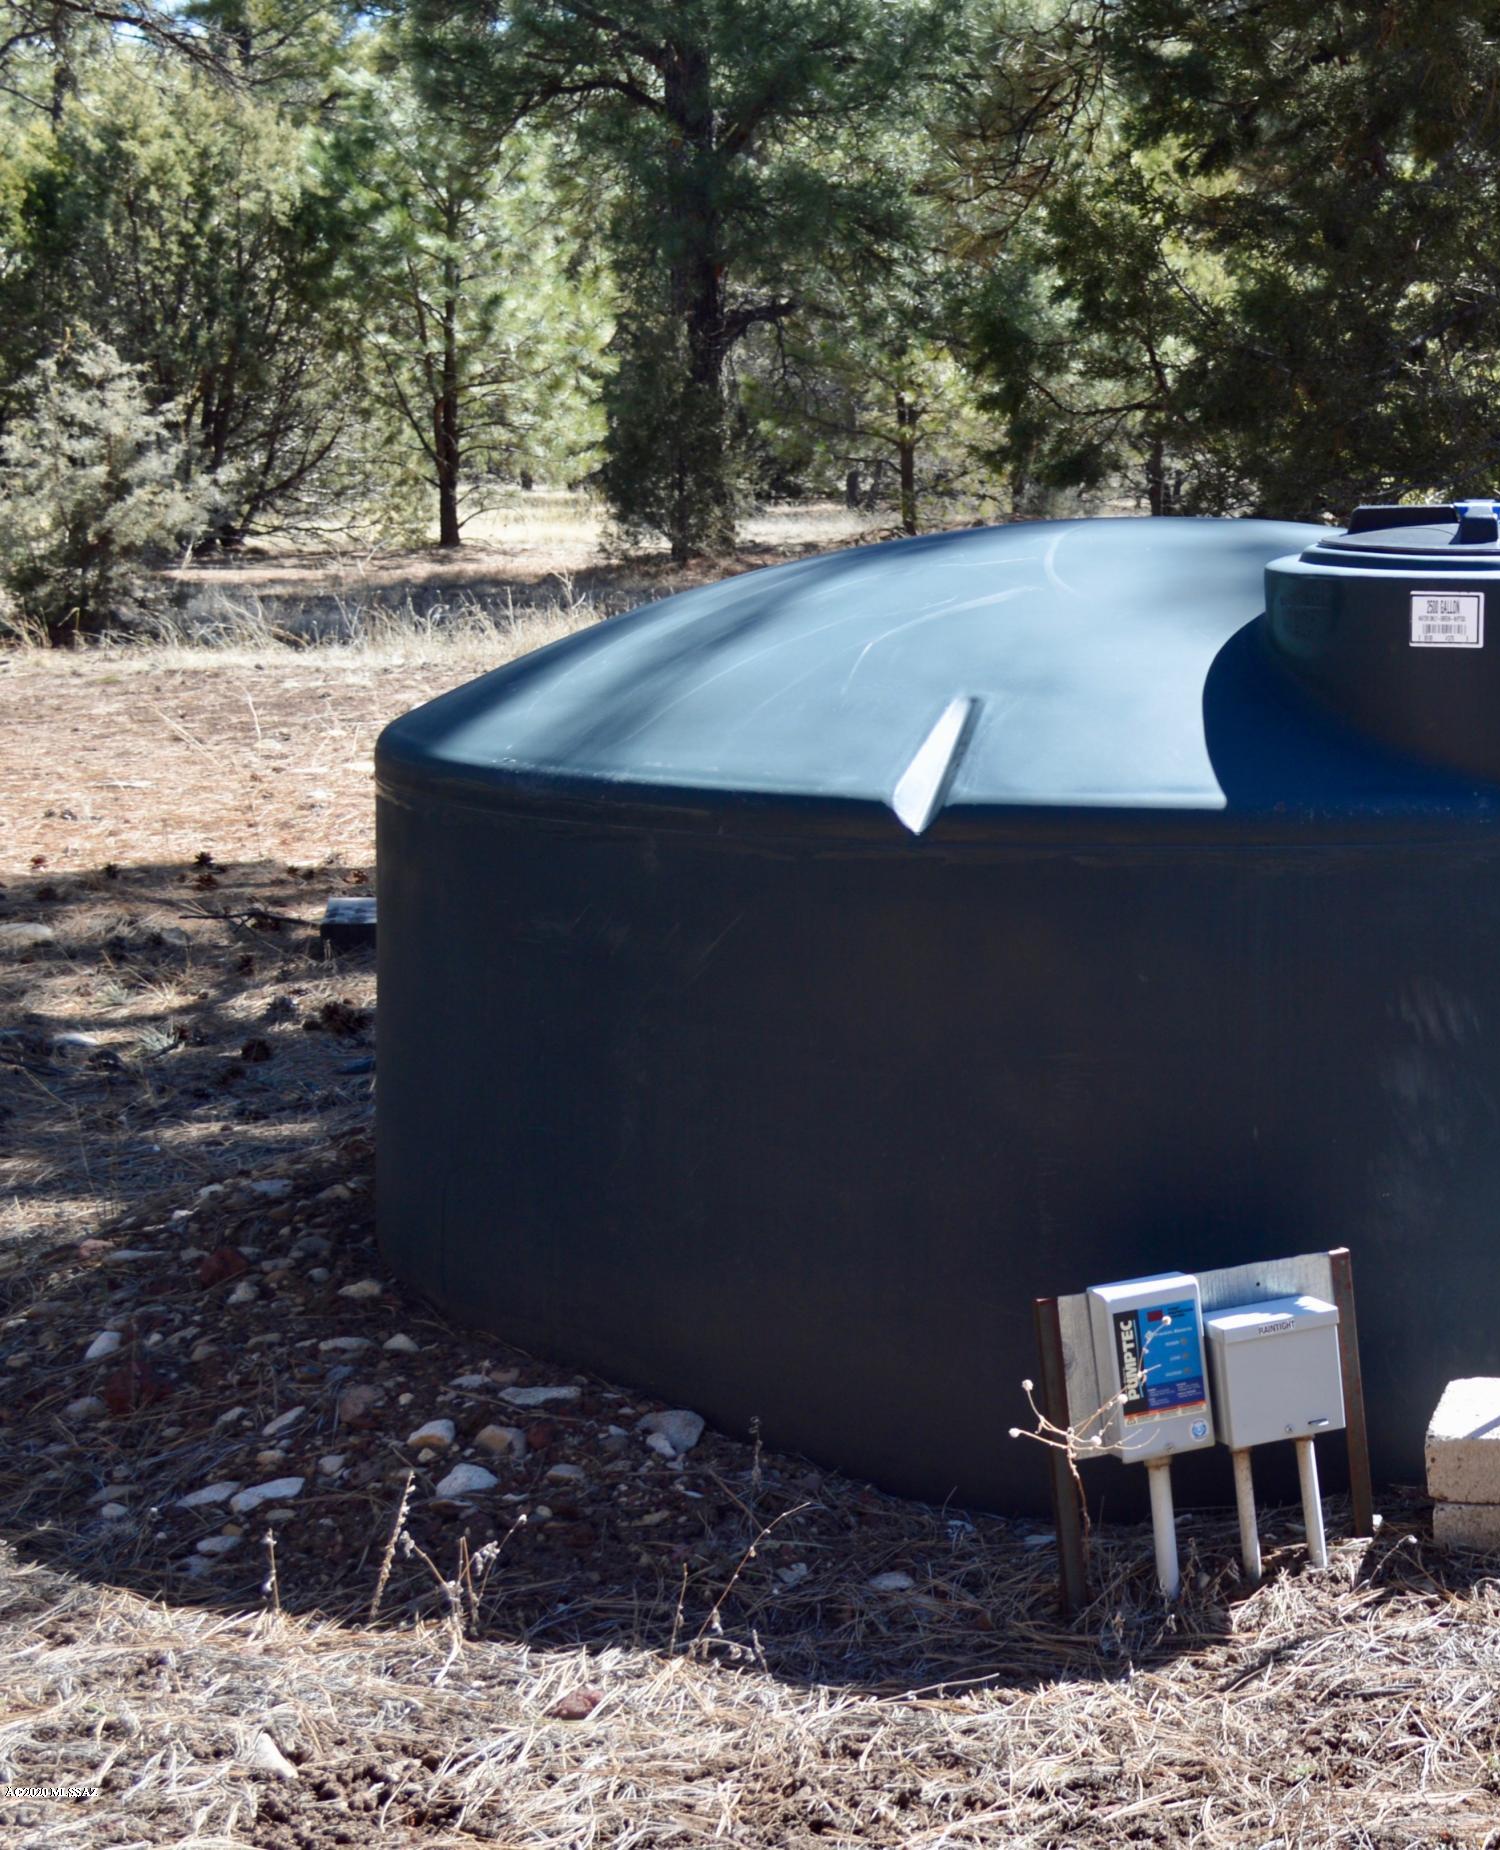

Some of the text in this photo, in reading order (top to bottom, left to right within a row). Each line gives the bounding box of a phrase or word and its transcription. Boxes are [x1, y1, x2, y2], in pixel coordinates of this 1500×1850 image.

[1440, 599, 1460, 614] GALLON
[1257, 1319, 1295, 1335] RAINTIGHT
[1120, 1319, 1141, 1401] PUMPTEC
